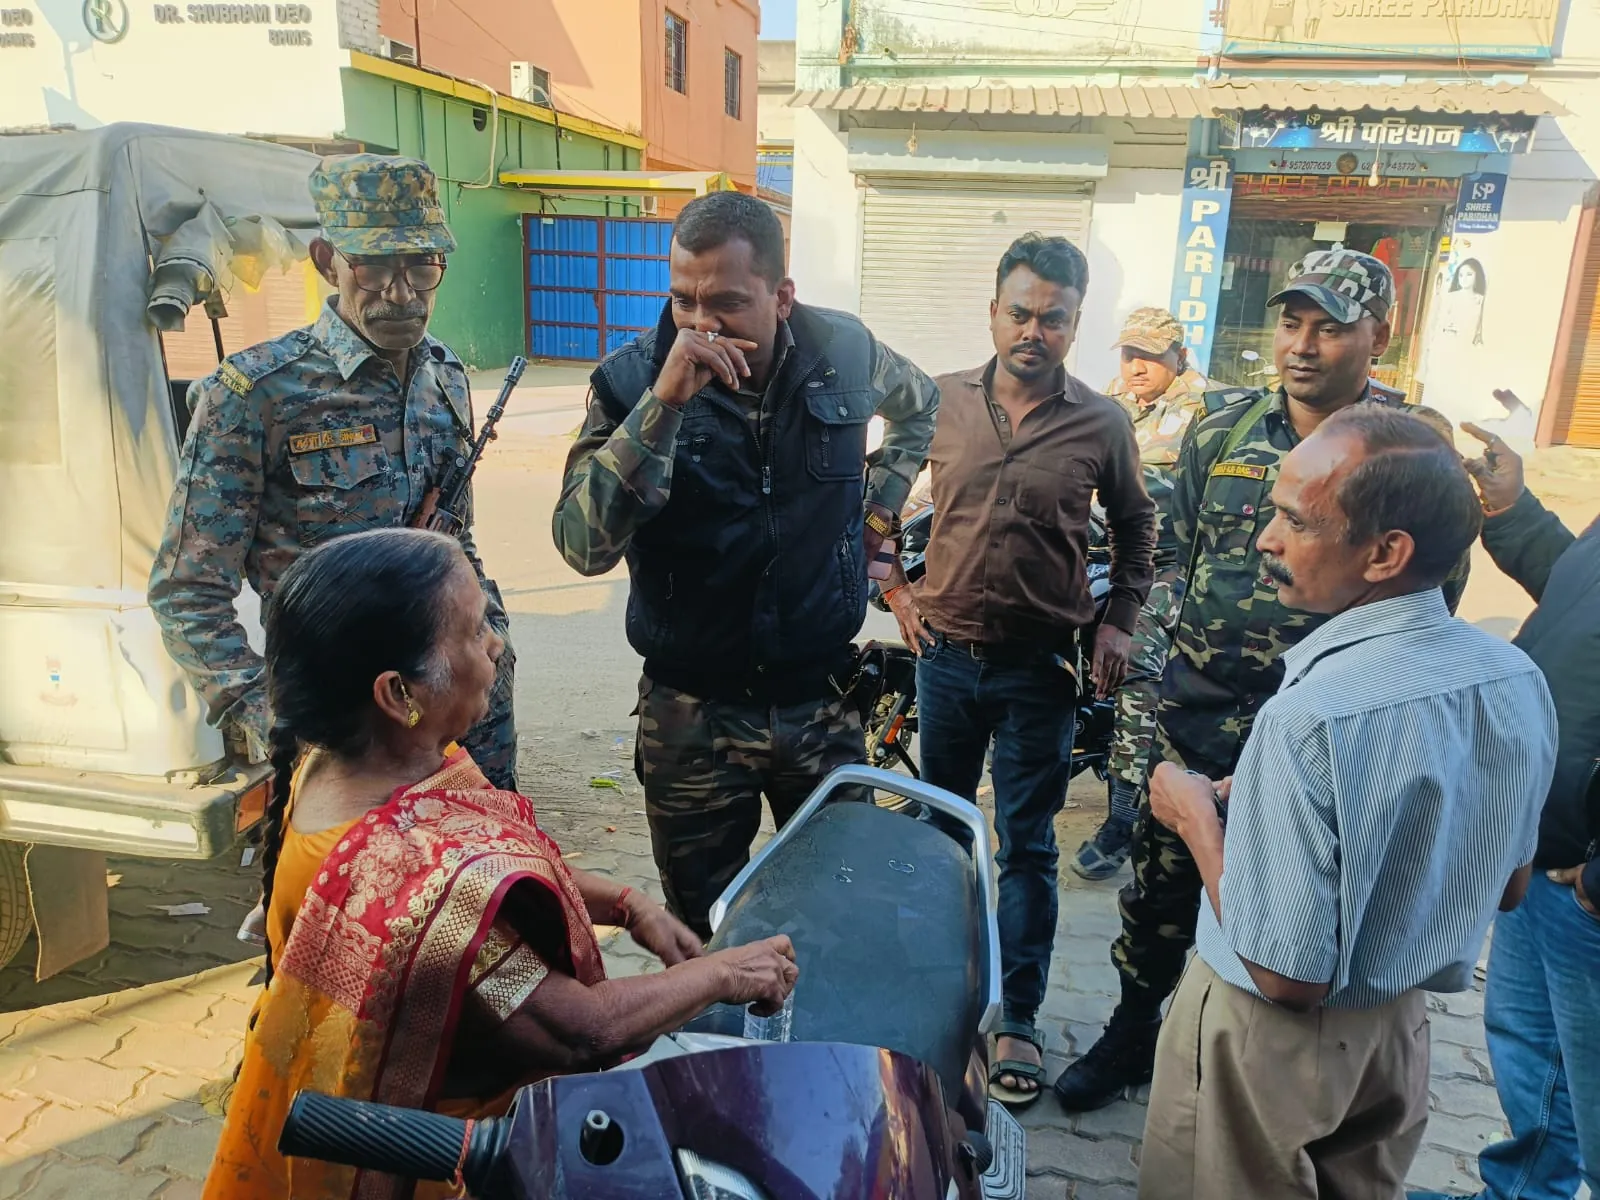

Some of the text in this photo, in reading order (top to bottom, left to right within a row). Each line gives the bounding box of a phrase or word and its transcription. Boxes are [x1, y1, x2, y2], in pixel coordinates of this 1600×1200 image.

[154, 4, 312, 24] DR. SHUBHAM DEO
[1319, 116, 1464, 147] श्री परिधान
[1189, 160, 1230, 191] श्री
[1457, 211, 1499, 222] PARIDHAN
[1464, 202, 1493, 212] SHREE
